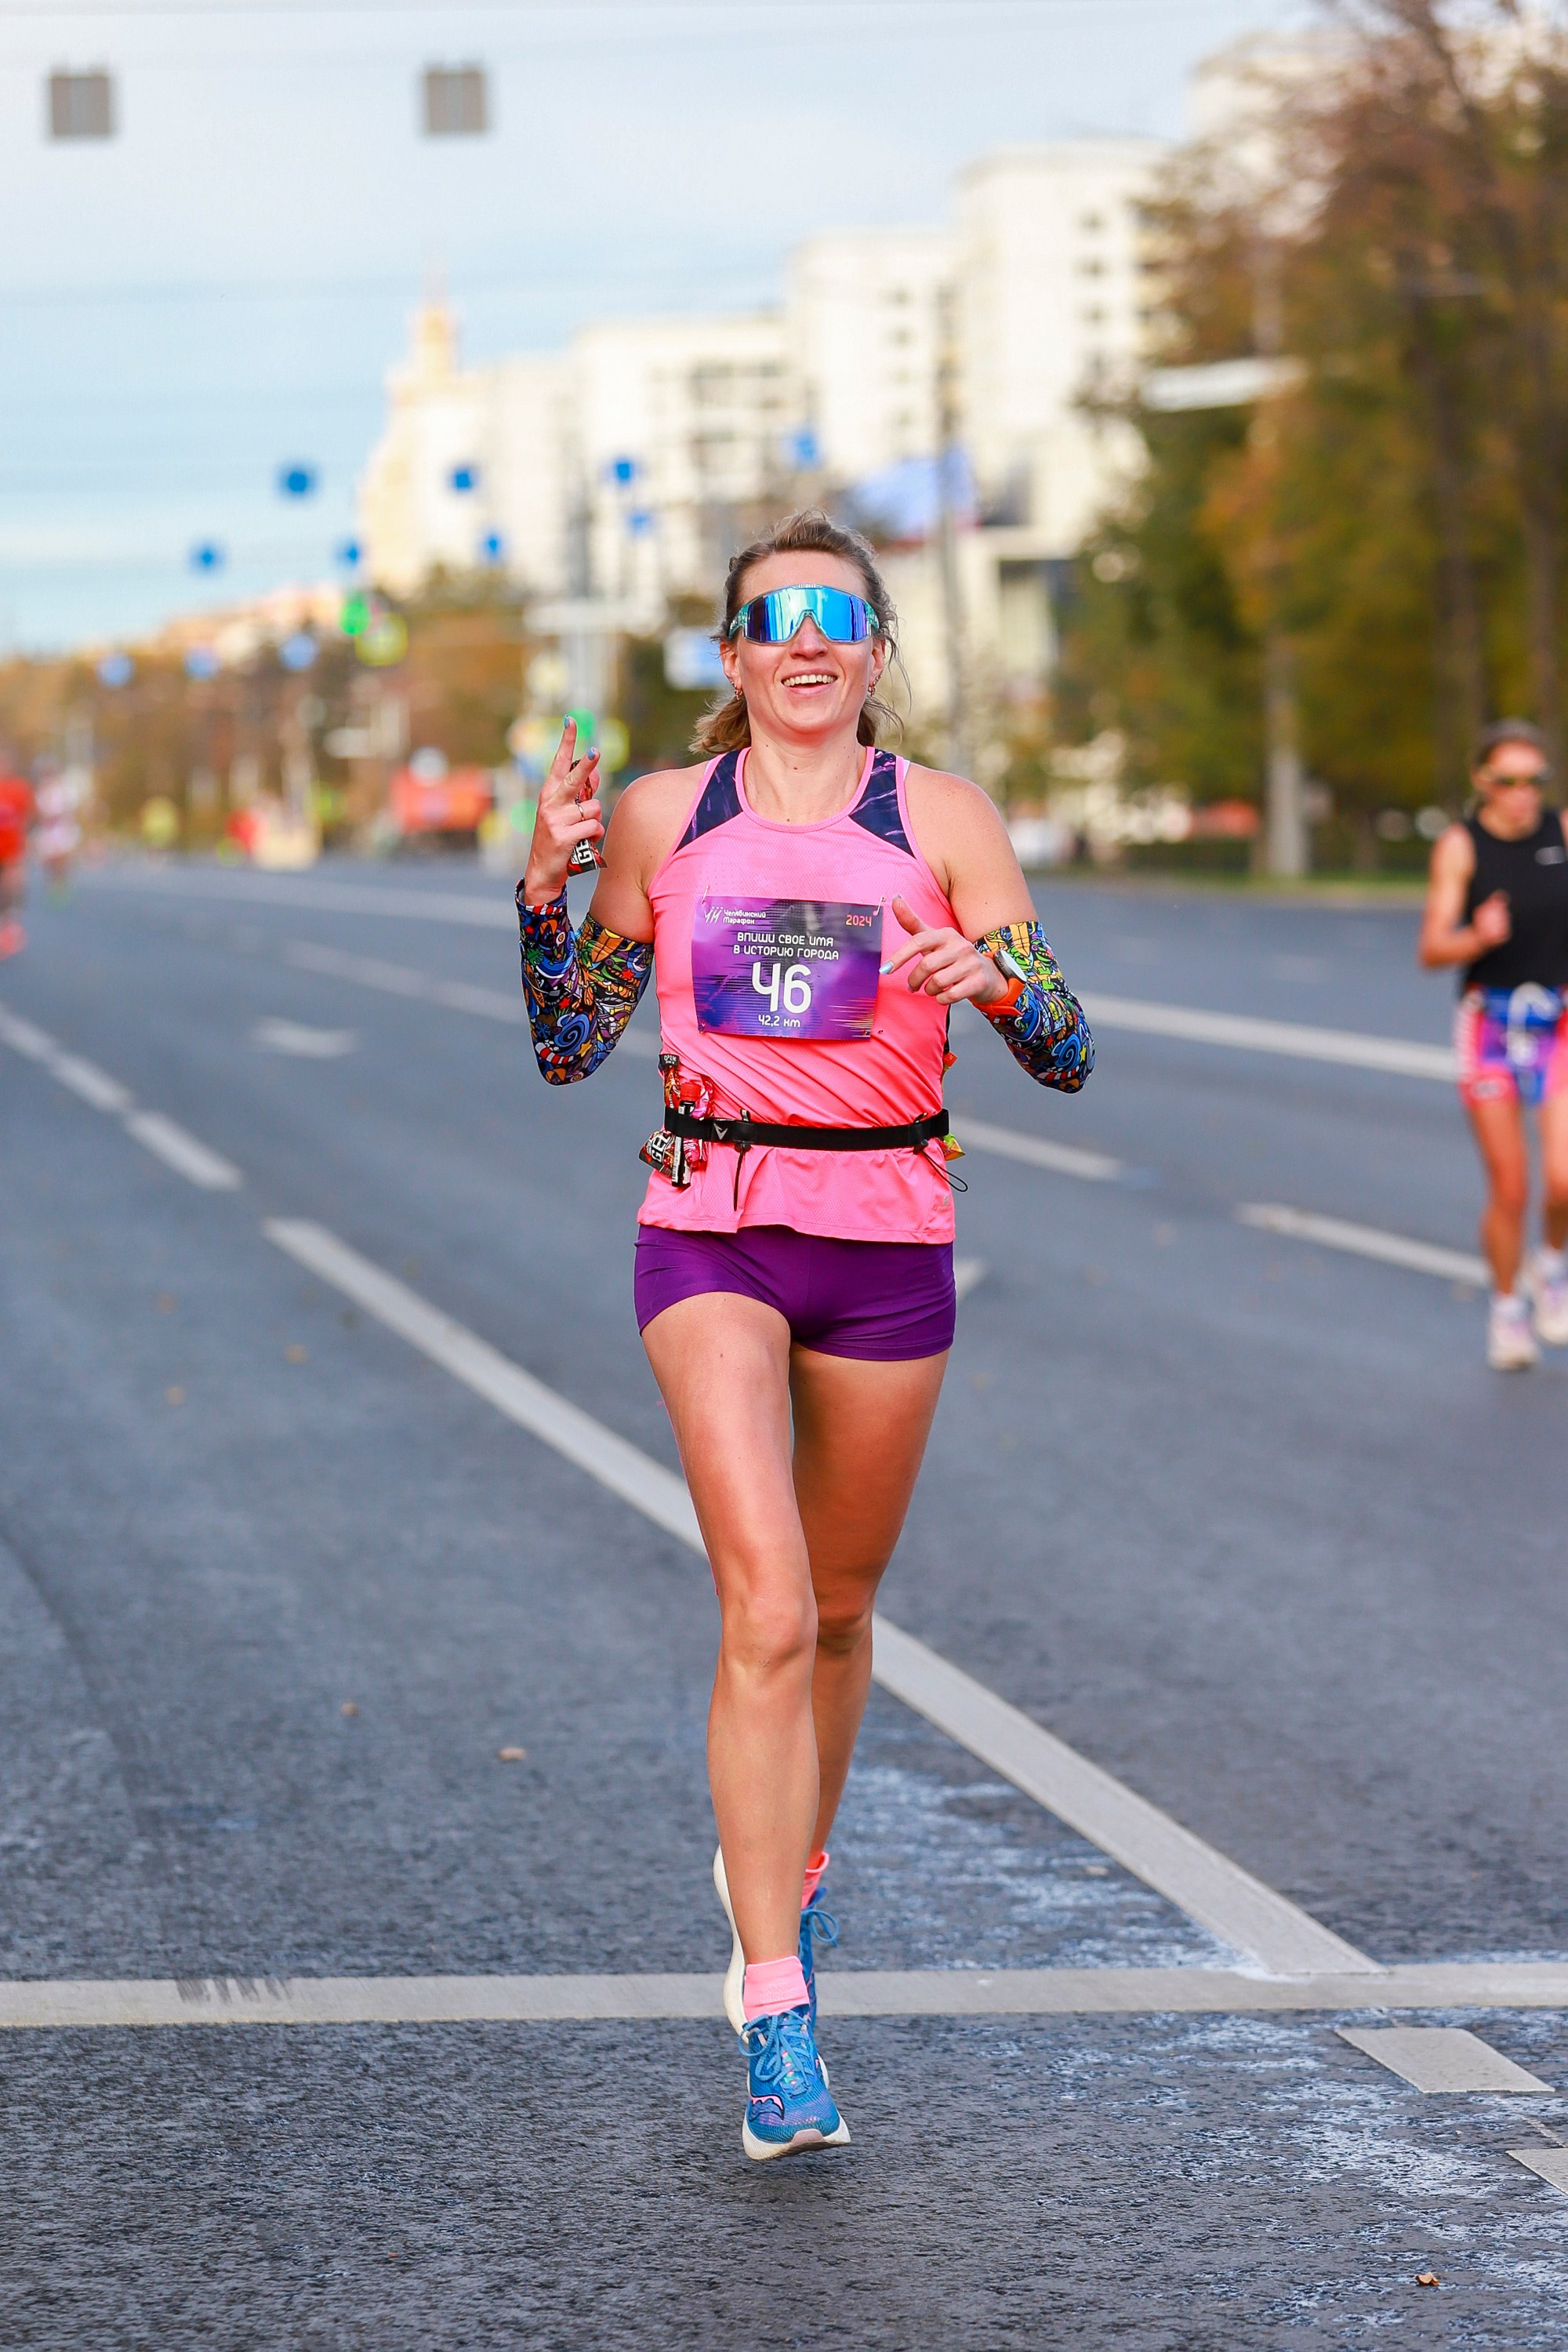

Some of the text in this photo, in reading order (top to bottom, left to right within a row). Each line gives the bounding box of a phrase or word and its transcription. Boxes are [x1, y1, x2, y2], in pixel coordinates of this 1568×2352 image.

[724, 909, 766, 918] Челябинский
[845, 915, 872, 927] 2024
[737, 932, 833, 947] ВПИШИ СВОЕ ИМЯ
[733, 944, 839, 960] В ИСТОРИЮ ГОРОДА
[752, 962, 811, 1014] 46
[758, 1014, 800, 1028] 42,2 км
[651, 1135, 670, 1163] GEL
